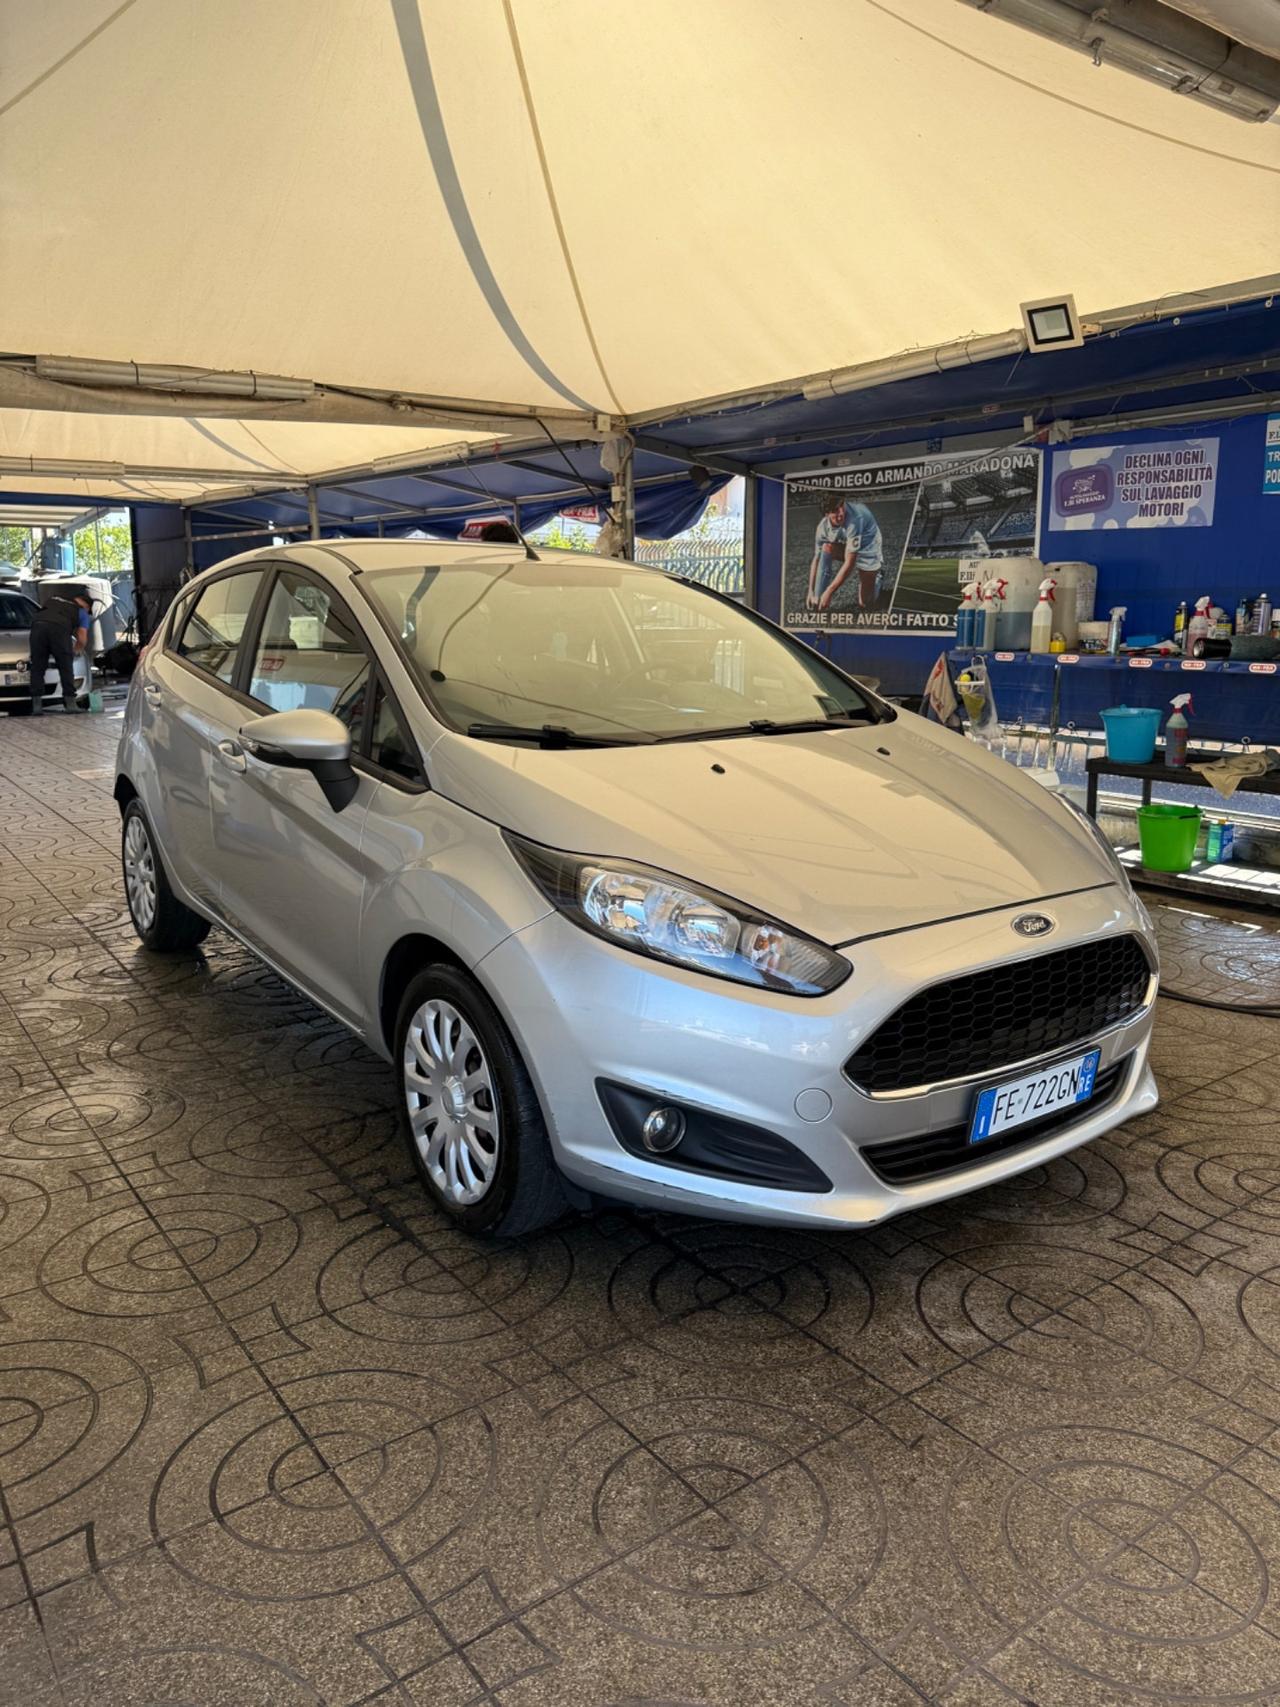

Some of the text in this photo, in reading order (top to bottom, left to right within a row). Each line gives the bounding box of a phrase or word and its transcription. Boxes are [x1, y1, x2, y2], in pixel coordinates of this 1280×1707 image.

[1125, 450, 1204, 469] DECLINA OGNI
[789, 454, 1035, 493] STADIO DIEGO ARMANDO MARADONA
[1117, 464, 1213, 486] RESPONSABILITÀ
[1122, 484, 1202, 502] SUL LAVAGGIO
[1138, 502, 1184, 518] MOTORI
[787, 612, 828, 625] GRAZIE
[830, 613, 854, 625] PER
[856, 613, 903, 627] AVERCI
[906, 613, 949, 627] FATTO
[1022, 918, 1047, 933] Ford
